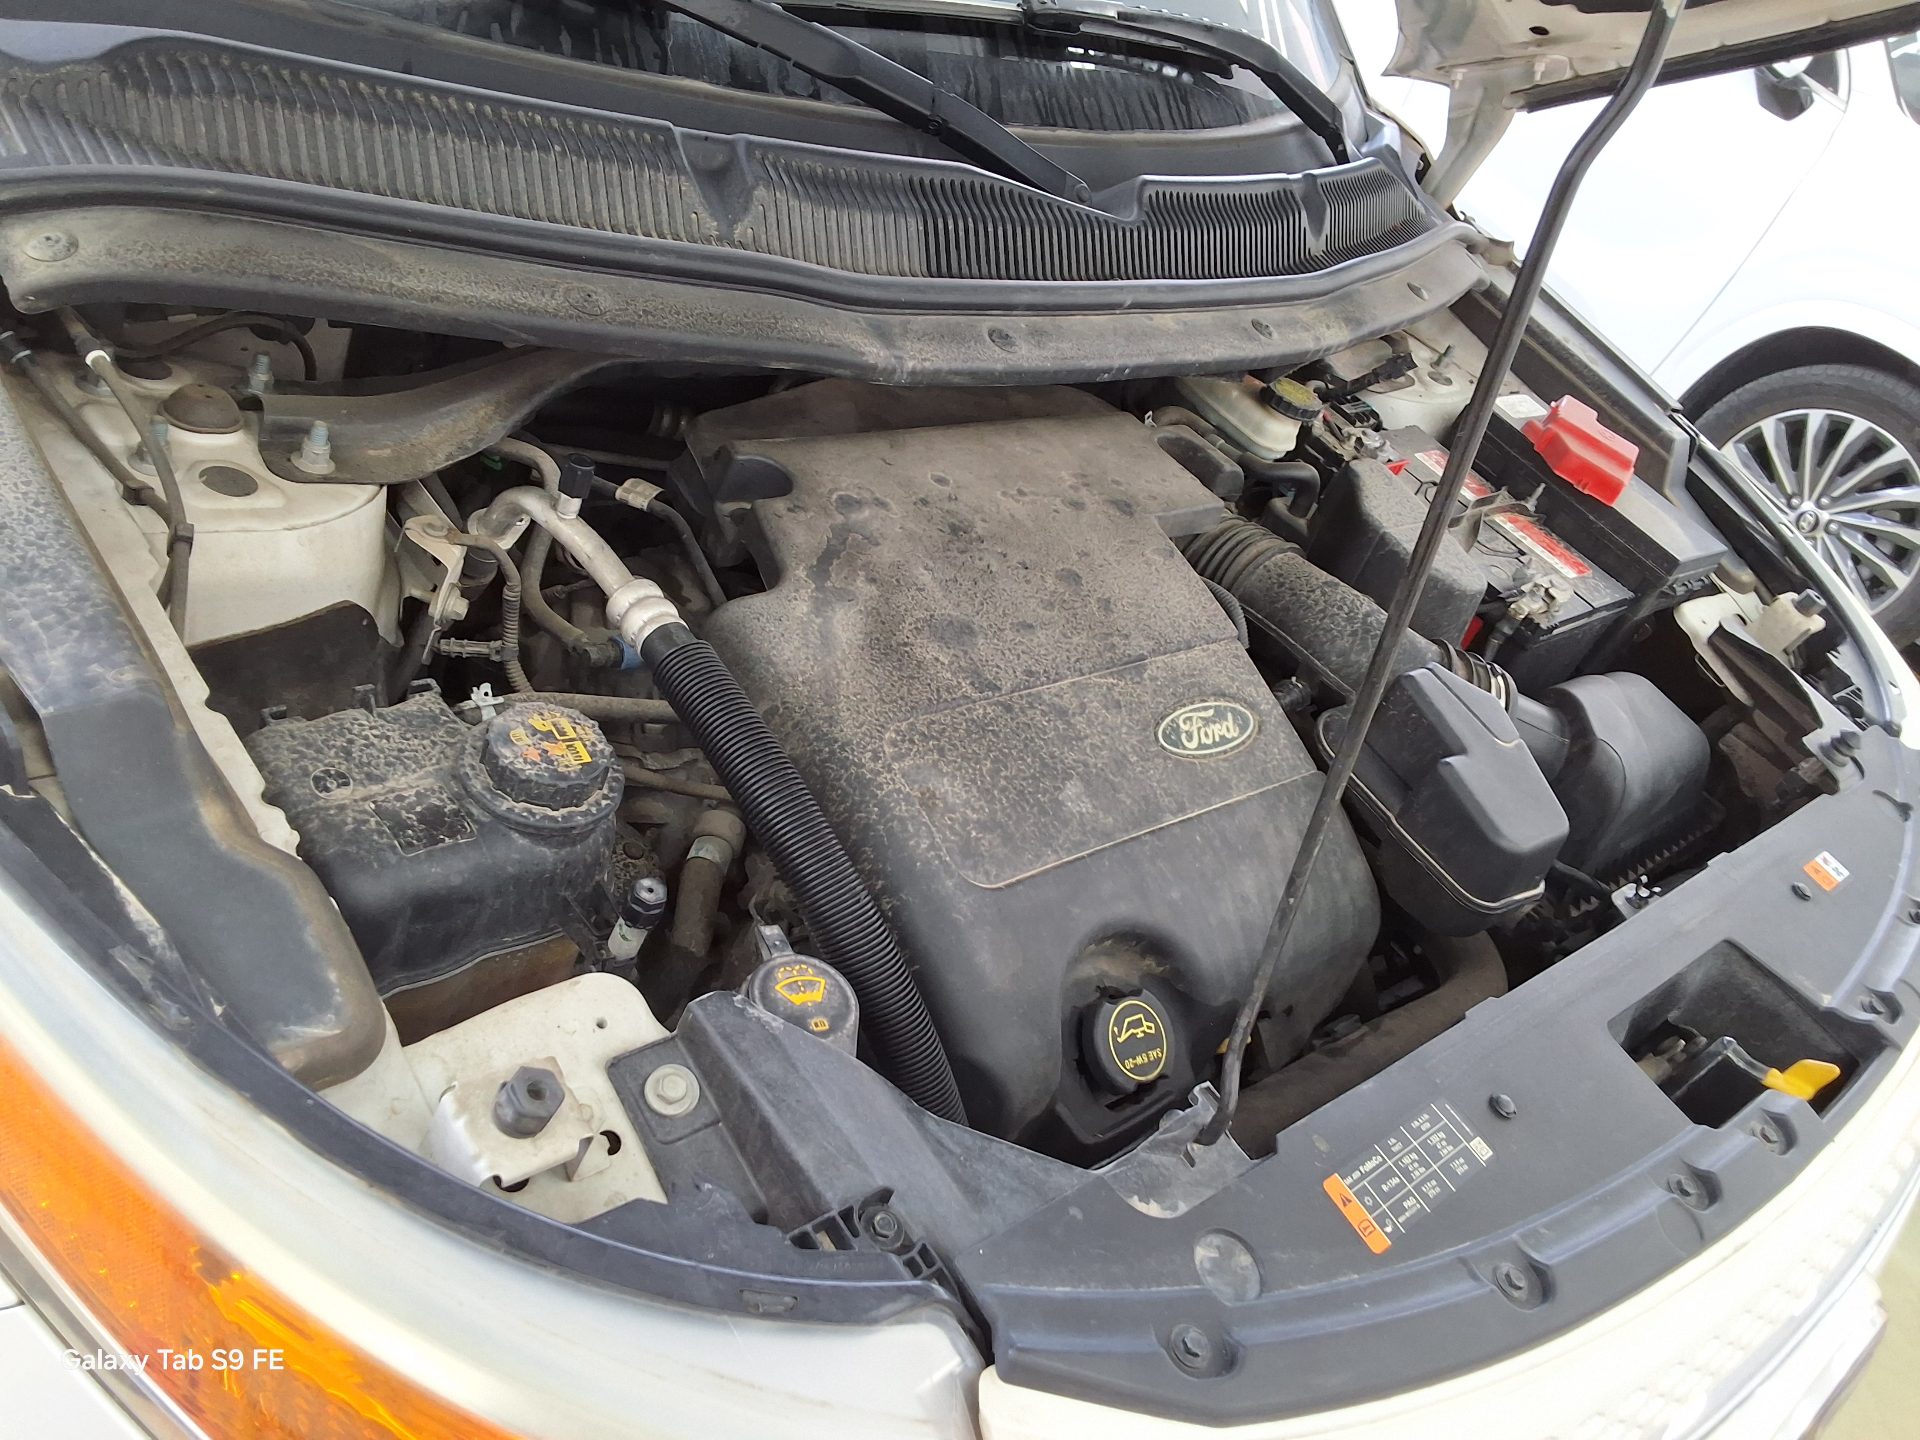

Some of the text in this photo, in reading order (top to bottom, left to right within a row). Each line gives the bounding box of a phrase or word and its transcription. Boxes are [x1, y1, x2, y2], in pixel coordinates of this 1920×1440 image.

[1179, 708, 1240, 749] Ford
[1124, 1047, 1163, 1070] SAE 5W-20
